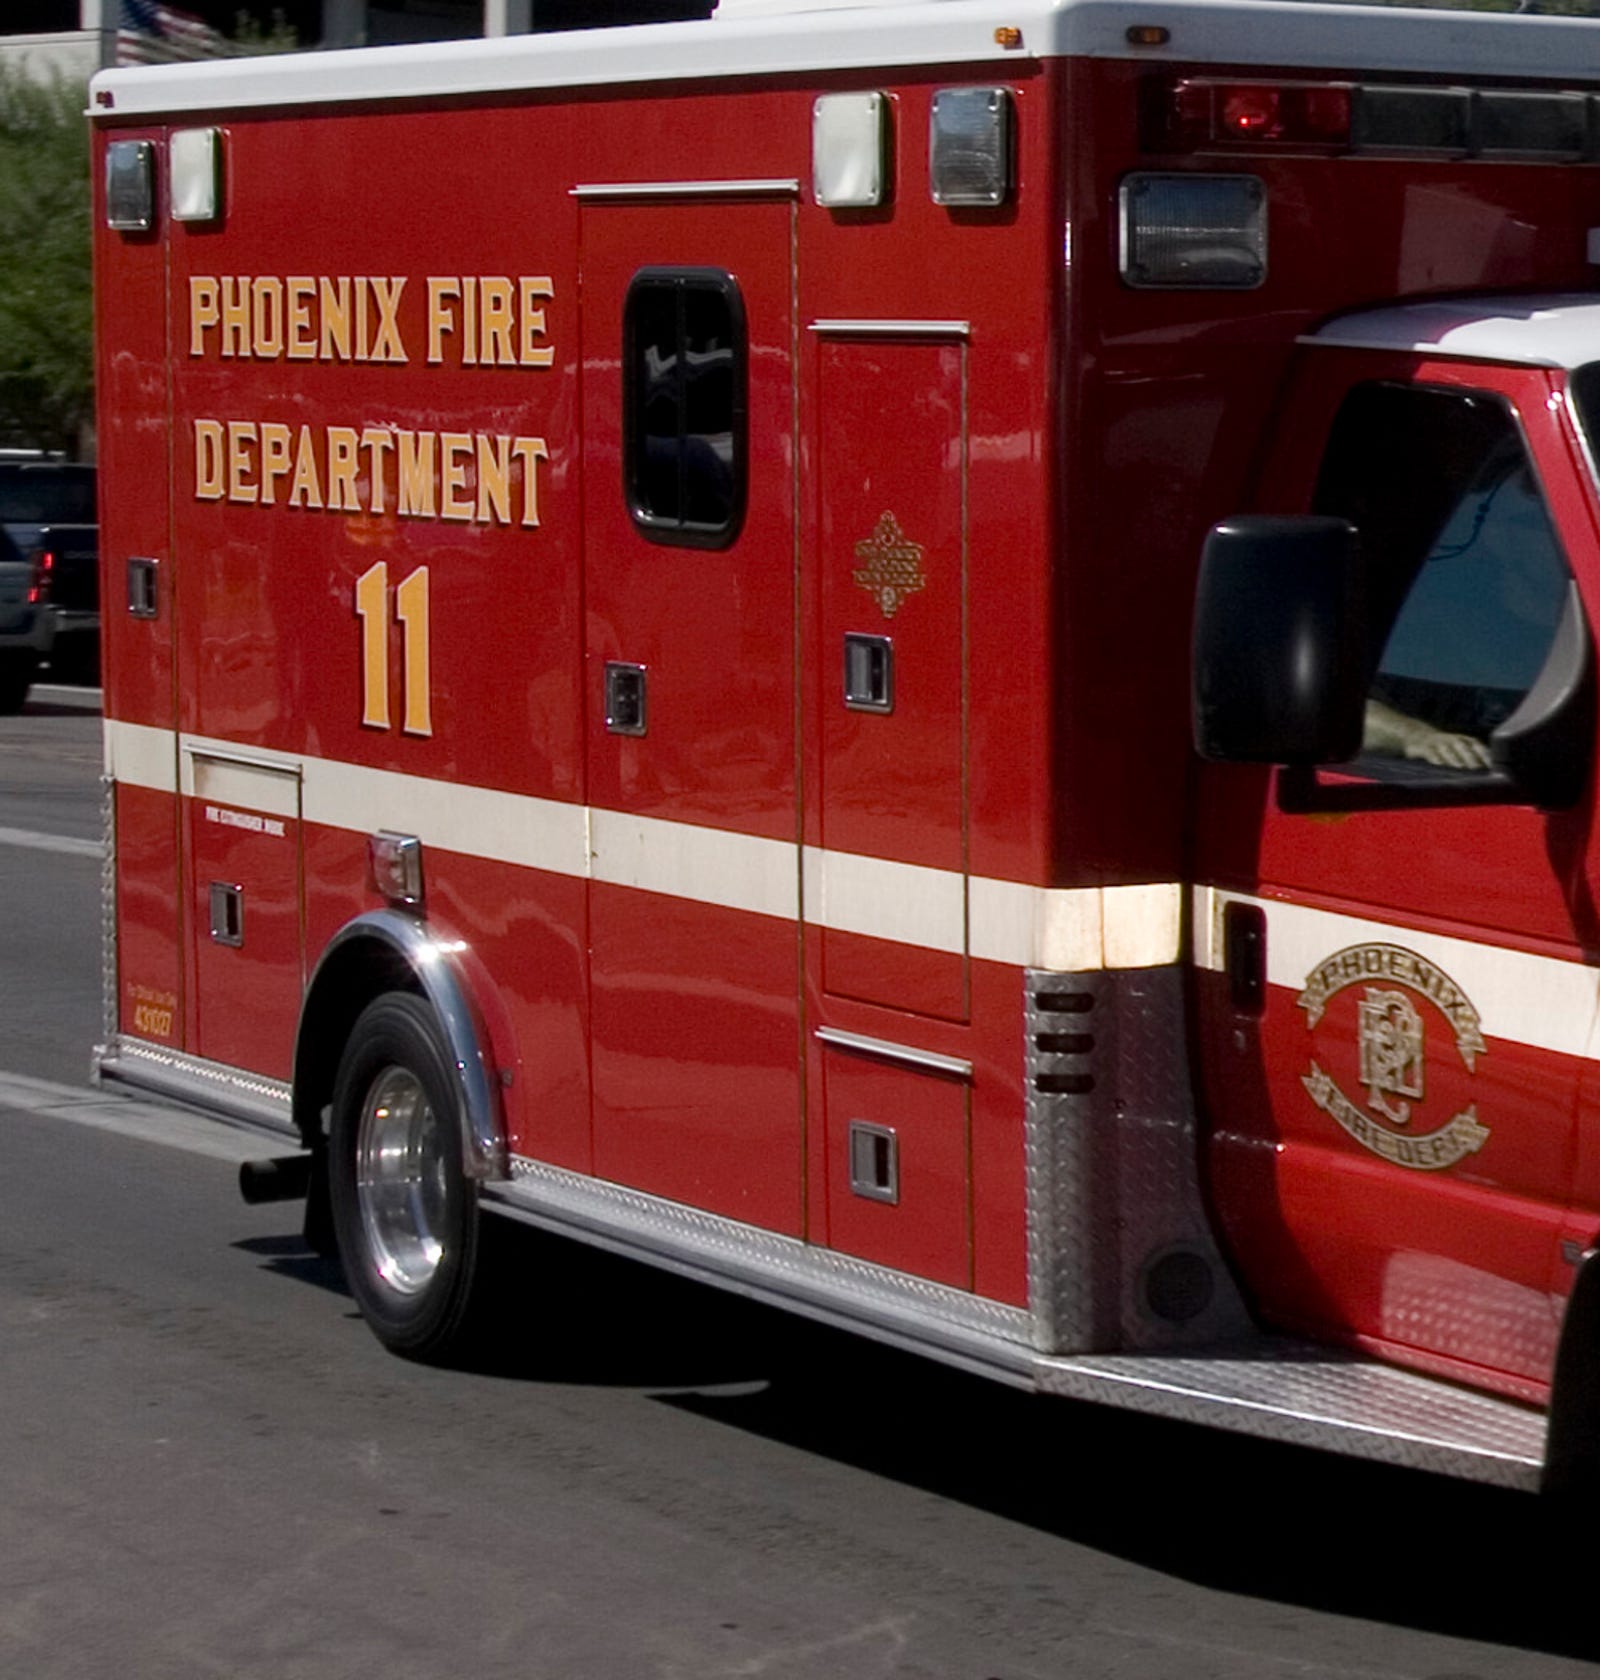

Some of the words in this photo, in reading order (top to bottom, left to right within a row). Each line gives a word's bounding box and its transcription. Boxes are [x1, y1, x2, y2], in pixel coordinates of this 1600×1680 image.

[189, 276, 409, 363] PHOENIX
[427, 276, 556, 366] FIRE
[194, 419, 549, 527] DEPARTMENT
[356, 561, 433, 737] 11
[1320, 948, 1466, 1022] PHOENIX
